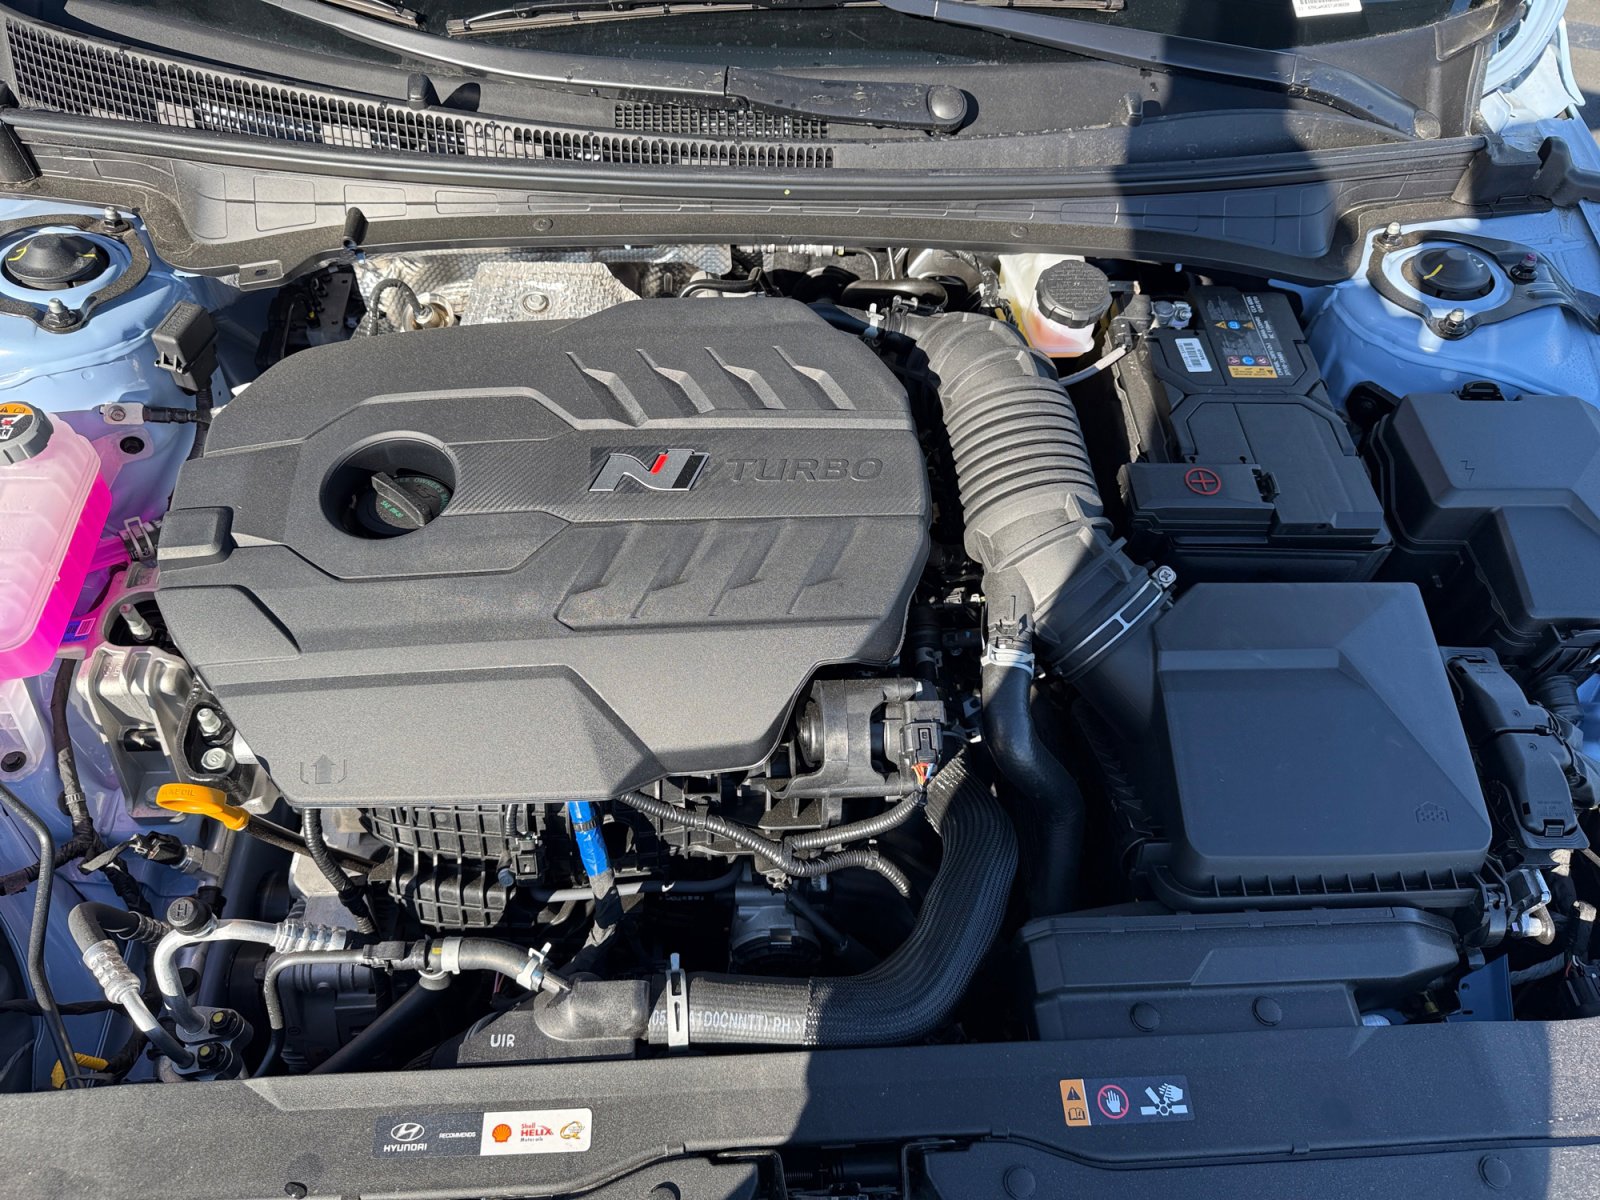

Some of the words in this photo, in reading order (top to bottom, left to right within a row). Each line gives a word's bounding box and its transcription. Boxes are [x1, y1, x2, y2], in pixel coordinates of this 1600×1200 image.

[725, 457, 885, 482] TURBO
[438, 1131, 476, 1139] RECOMMENDS
[520, 1126, 552, 1137] HELIX
[383, 1142, 428, 1153] HYUNDAI
